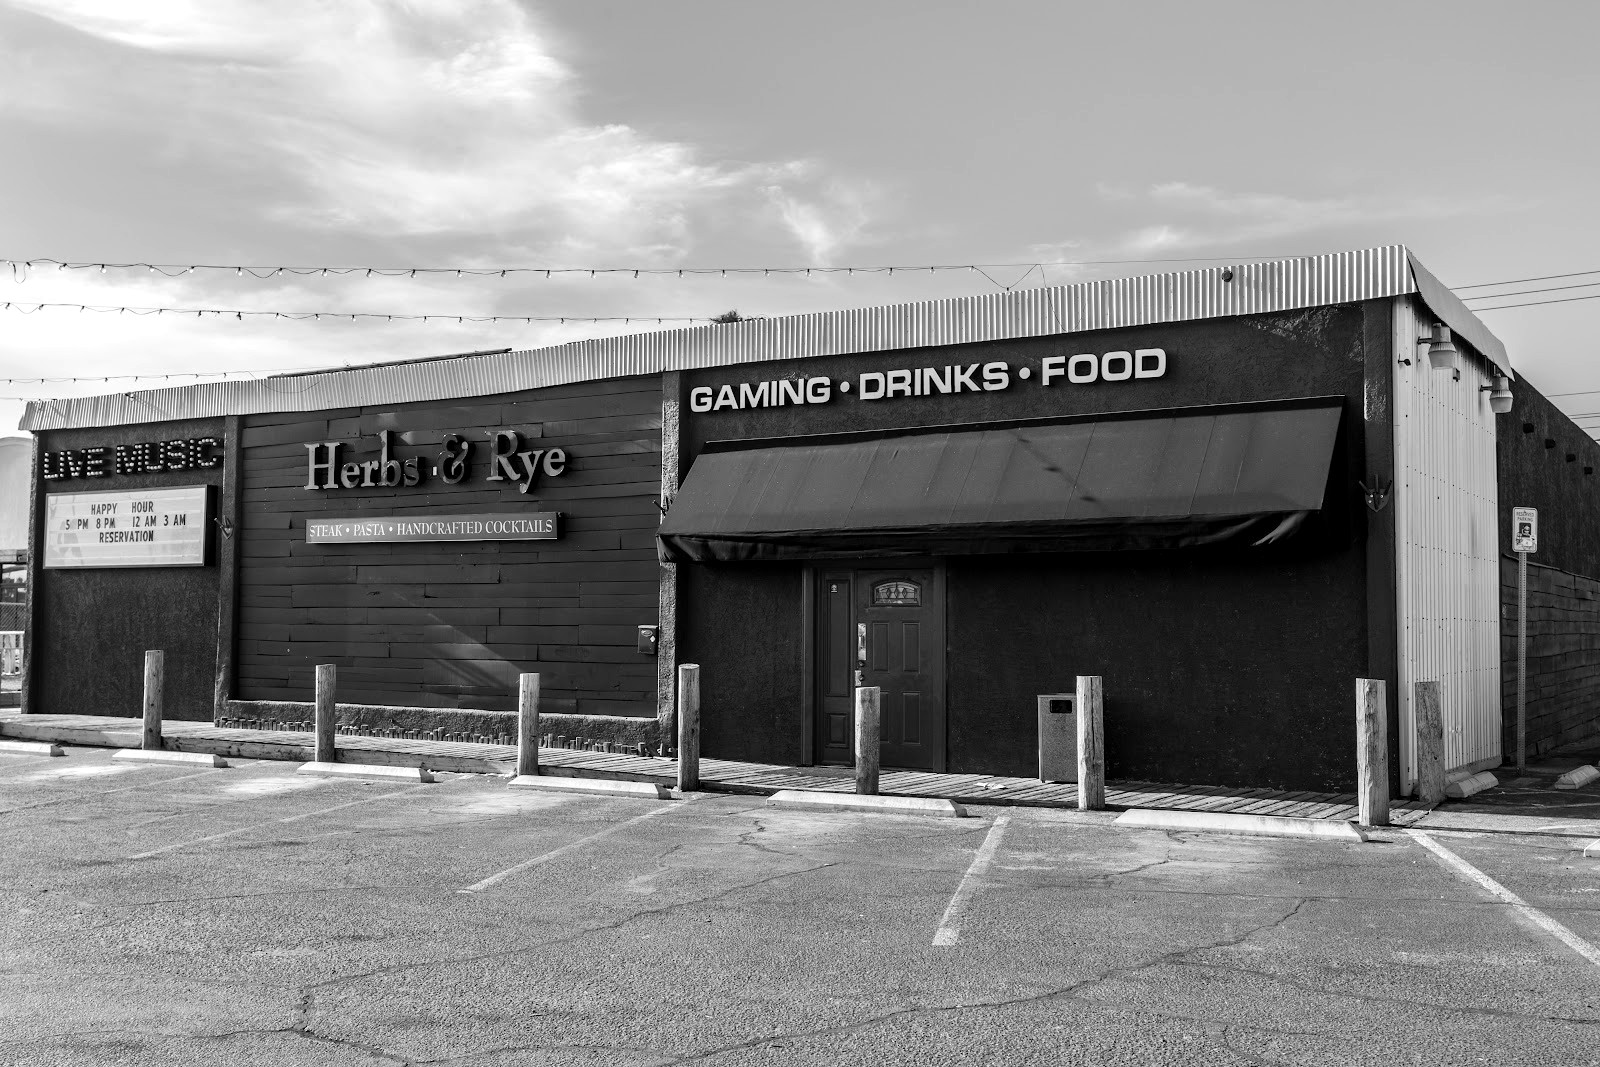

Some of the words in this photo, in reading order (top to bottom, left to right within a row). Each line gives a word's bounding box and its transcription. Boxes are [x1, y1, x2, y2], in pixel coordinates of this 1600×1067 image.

[690, 376, 831, 413] GAMING
[859, 361, 1010, 400] DRINKS
[1042, 347, 1167, 386] FOOD
[44, 446, 105, 479] LIVE
[116, 437, 218, 475] MUSIC
[303, 430, 420, 490] Herbs
[437, 433, 469, 484] &
[485, 430, 566, 494] Rye
[91, 503, 118, 515] HAPPY
[131, 501, 154, 513] HOUR
[65, 519, 71, 530] 5
[77, 518, 89, 529] PM
[95, 518, 101, 529] 8
[104, 517, 116, 529] PM
[132, 516, 140, 528] 12
[145, 515, 157, 527] AM
[163, 514, 169, 526] 3
[173, 514, 186, 526] AM
[309, 524, 343, 537] STEAK
[353, 523, 385, 537] PASTA
[397, 520, 482, 536] HANDCRAFTED
[485, 519, 553, 534] COCKTAILS
[99, 530, 154, 543] RESERVATION
